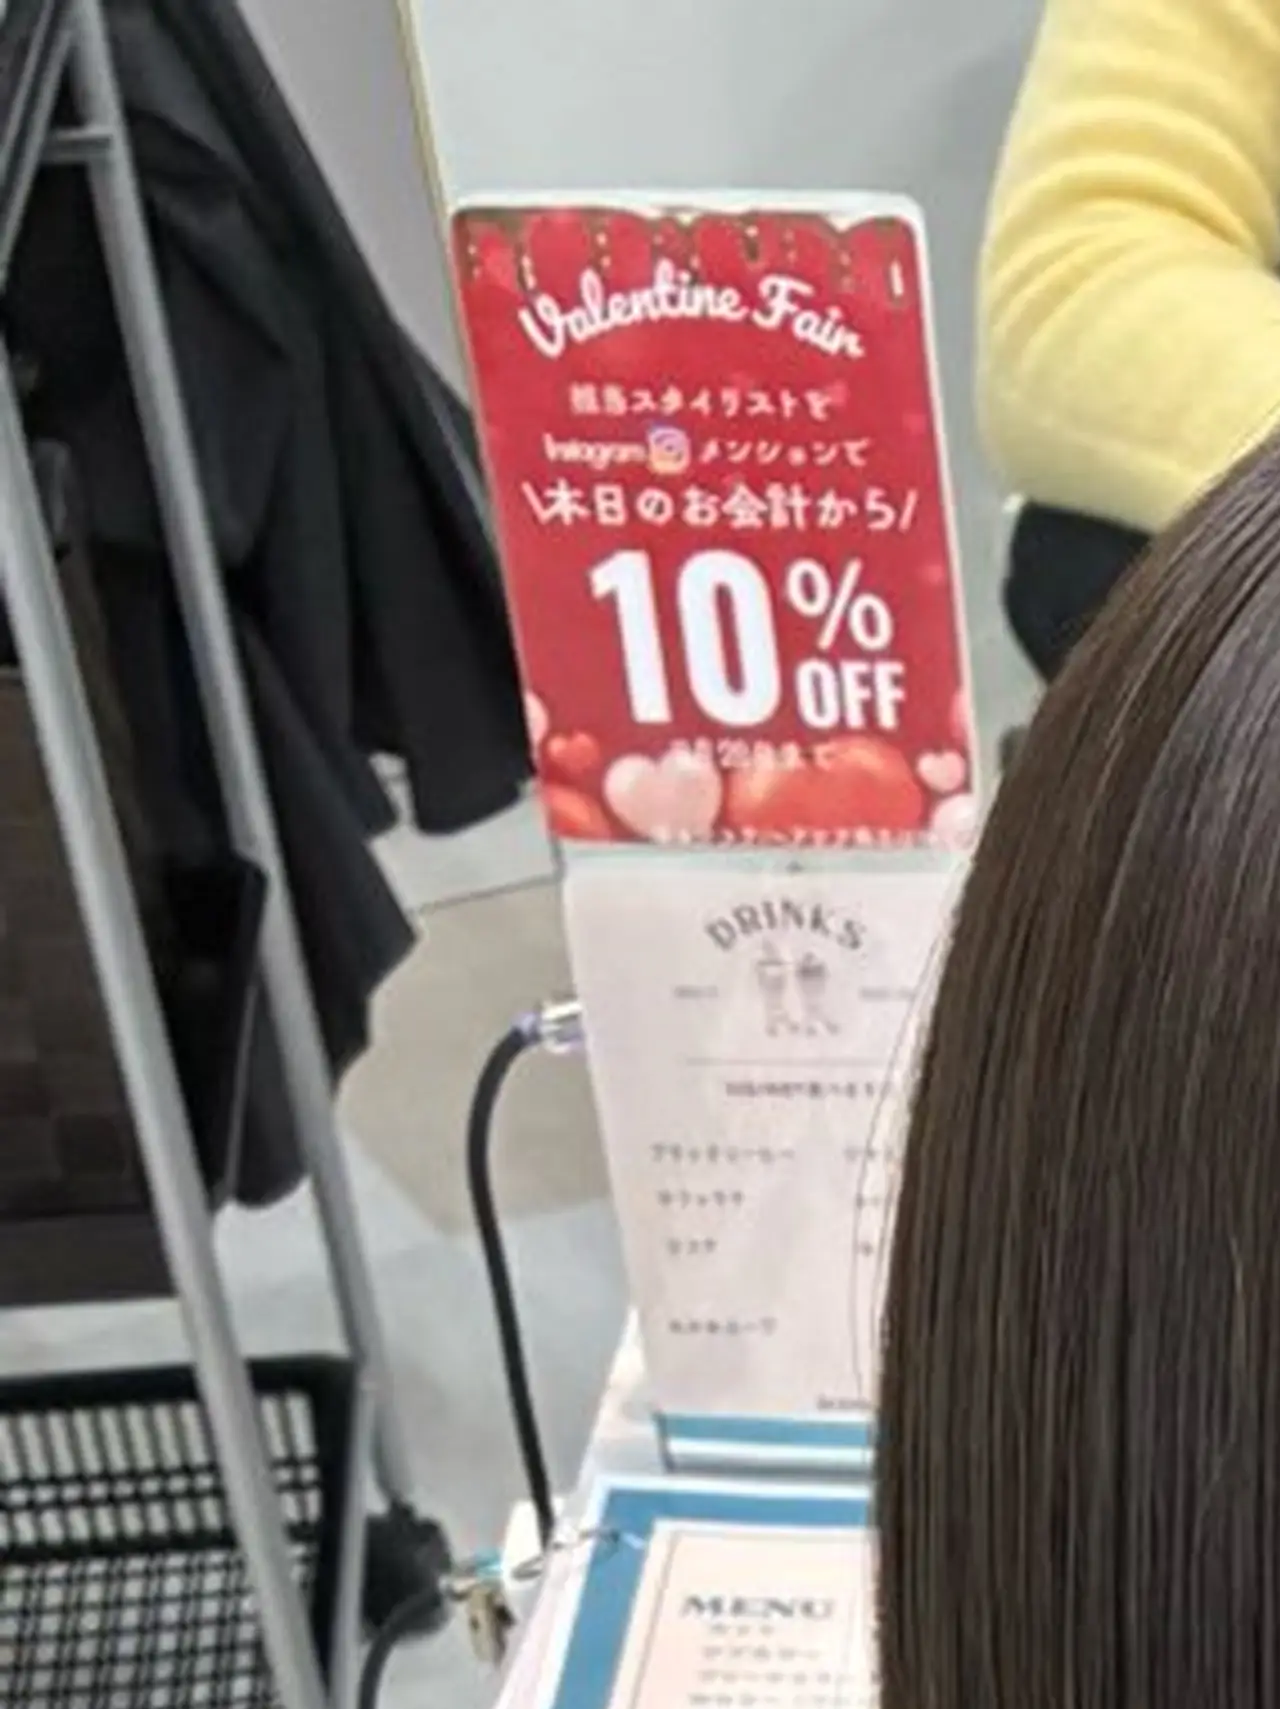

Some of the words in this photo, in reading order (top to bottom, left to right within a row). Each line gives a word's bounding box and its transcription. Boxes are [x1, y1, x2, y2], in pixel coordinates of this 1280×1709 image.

[518, 257, 749, 360] Valentine
[751, 273, 866, 359] Fair
[797, 658, 906, 730] OFF
[704, 895, 866, 952] DRINKS
[680, 1594, 834, 1620] MENU
